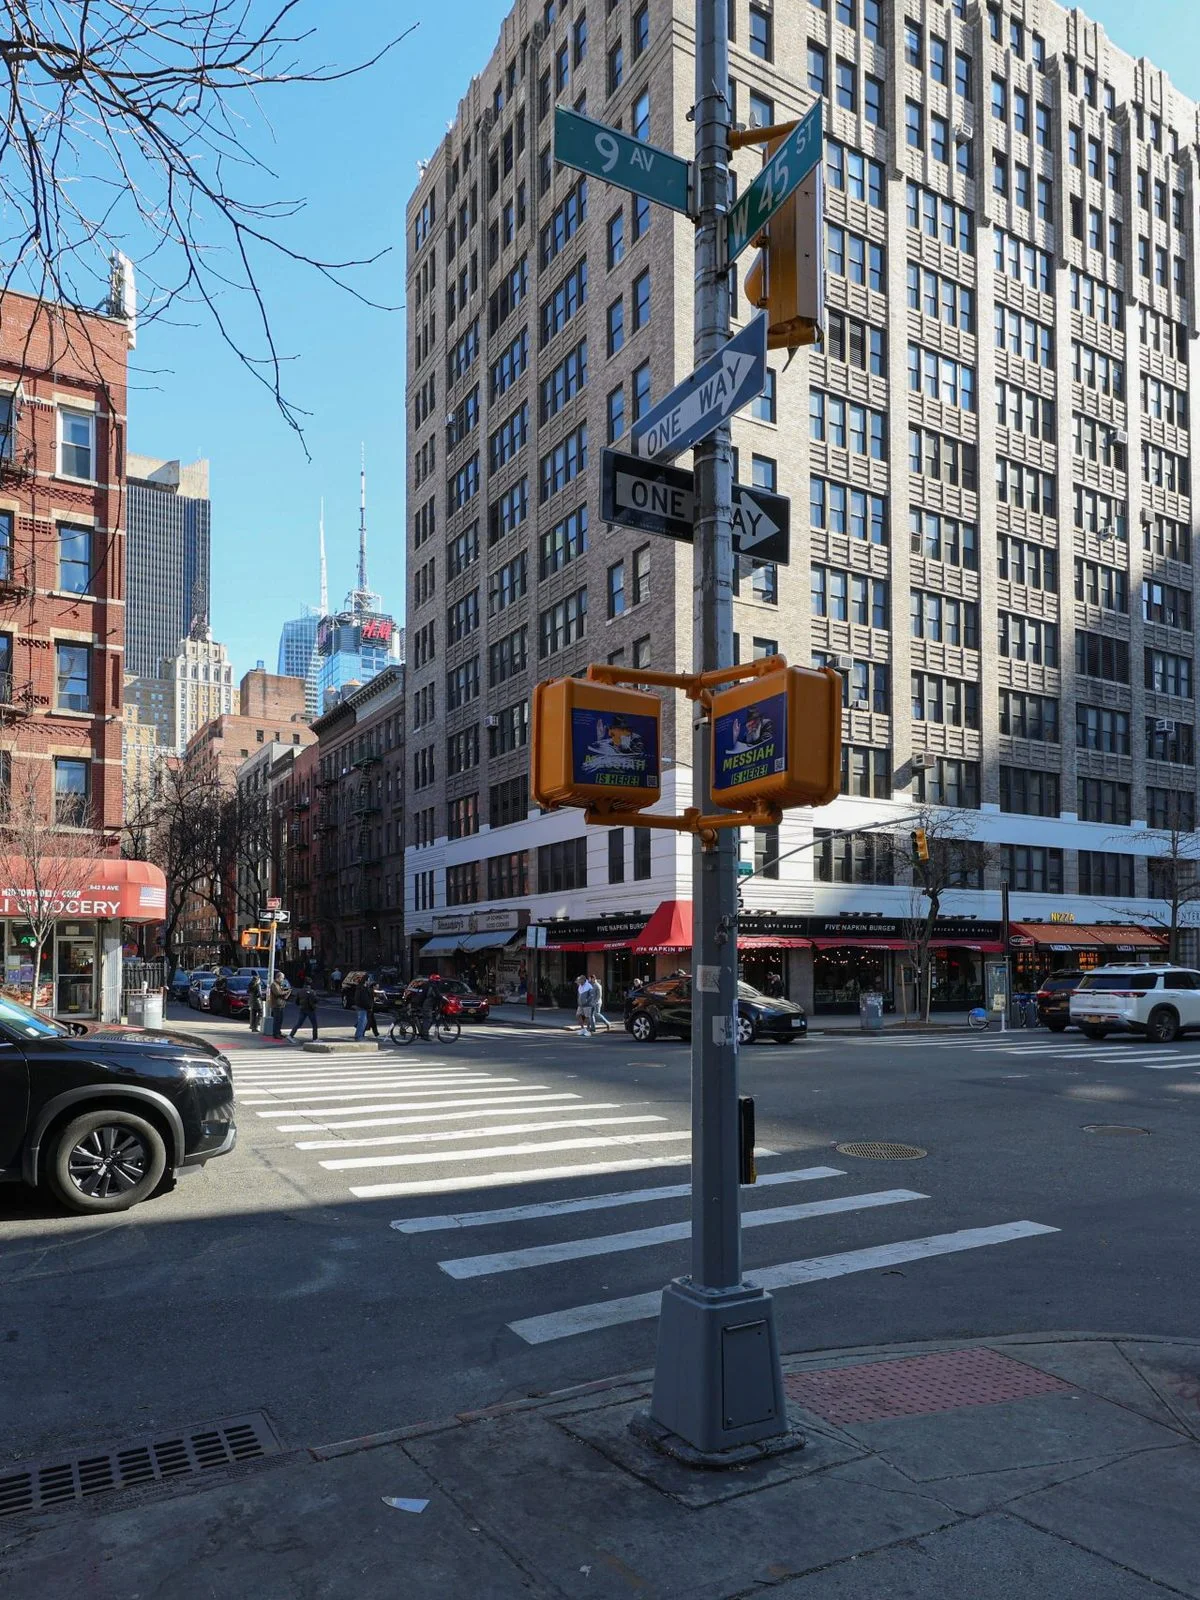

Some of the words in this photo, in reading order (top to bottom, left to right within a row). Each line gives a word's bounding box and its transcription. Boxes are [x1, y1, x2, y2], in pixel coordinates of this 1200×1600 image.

[594, 131, 619, 173] 9
[630, 150, 656, 172] AV
[731, 203, 749, 250] W
[757, 150, 789, 214] 45
[795, 114, 815, 154] ST
[647, 407, 682, 456] ONE
[698, 357, 743, 416] WAY
[631, 480, 686, 519] ONE
[731, 512, 763, 537] AY
[722, 743, 775, 772] MESSIAH
[597, 773, 607, 784] IS
[608, 774, 639, 785] HERE!
[732, 772, 742, 785] IS
[741, 764, 768, 782] HERE!
[17, 899, 120, 914] GROCERY
[1050, 911, 1075, 922] NIZZA
